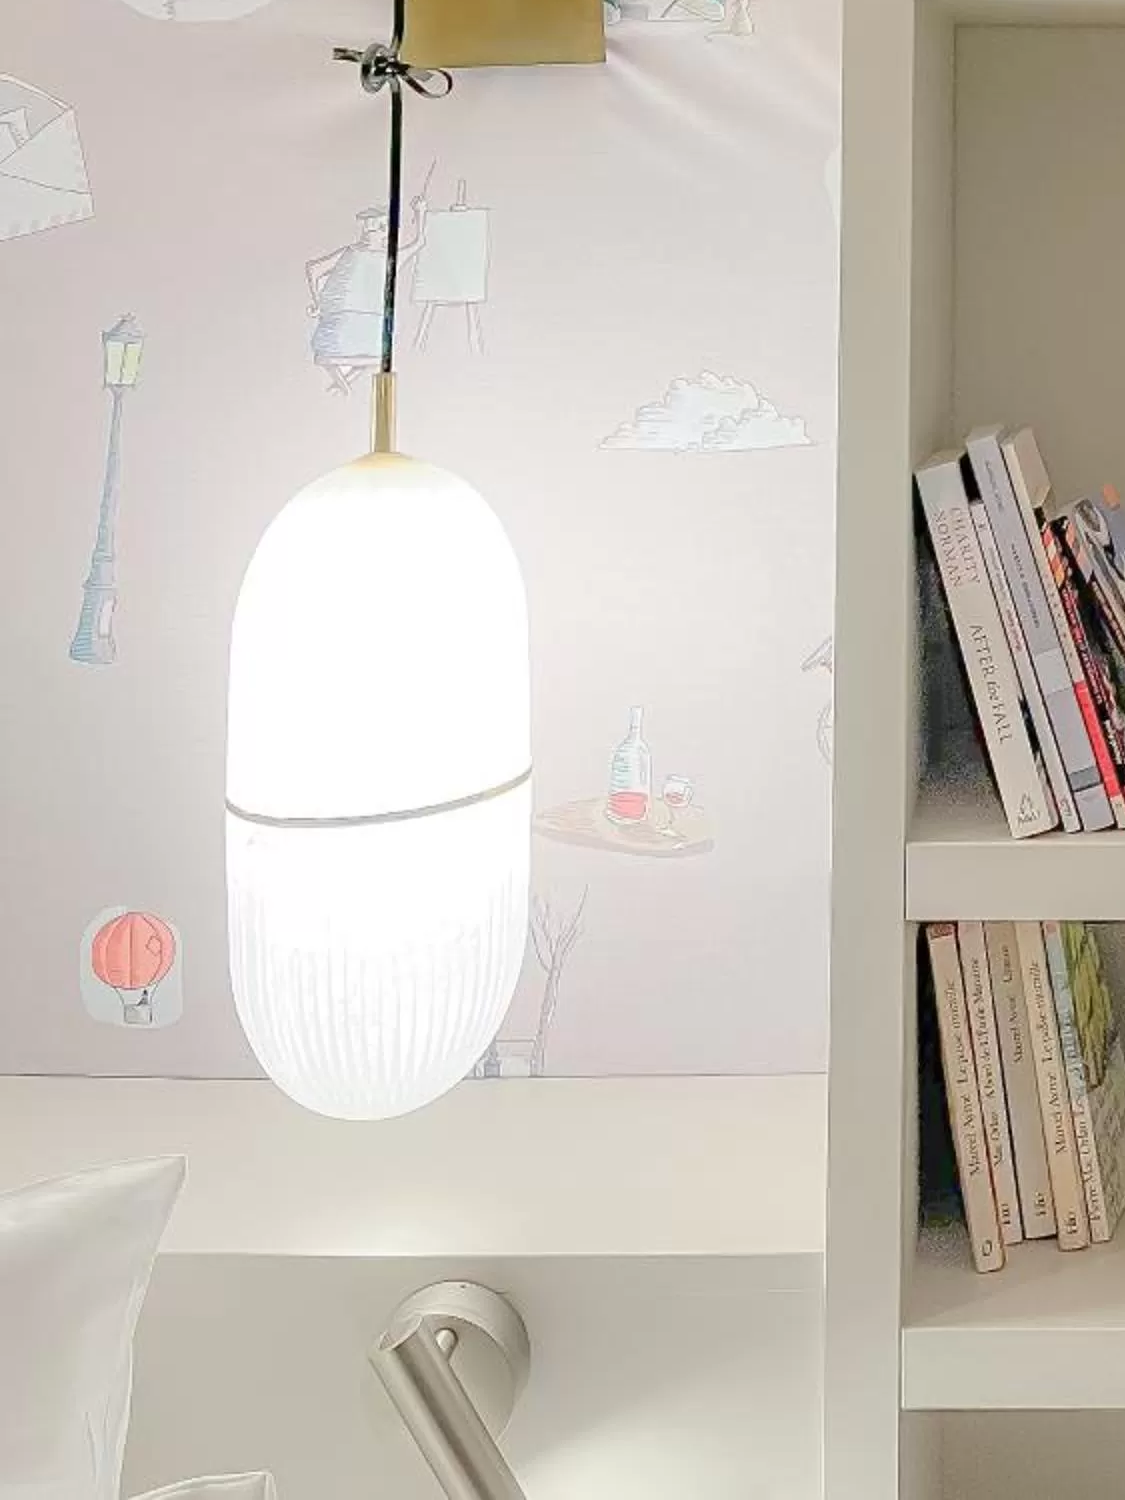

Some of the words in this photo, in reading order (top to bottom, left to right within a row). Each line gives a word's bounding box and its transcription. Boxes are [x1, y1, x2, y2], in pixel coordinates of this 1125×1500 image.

[932, 512, 963, 587] NORMAN
[950, 507, 980, 585] CHARITY
[970, 623, 996, 679] AFTER
[968, 1131, 985, 1176] Marcel
[1052, 1112, 1071, 1155] Marcel
[1074, 1121, 1093, 1156] Orlan
